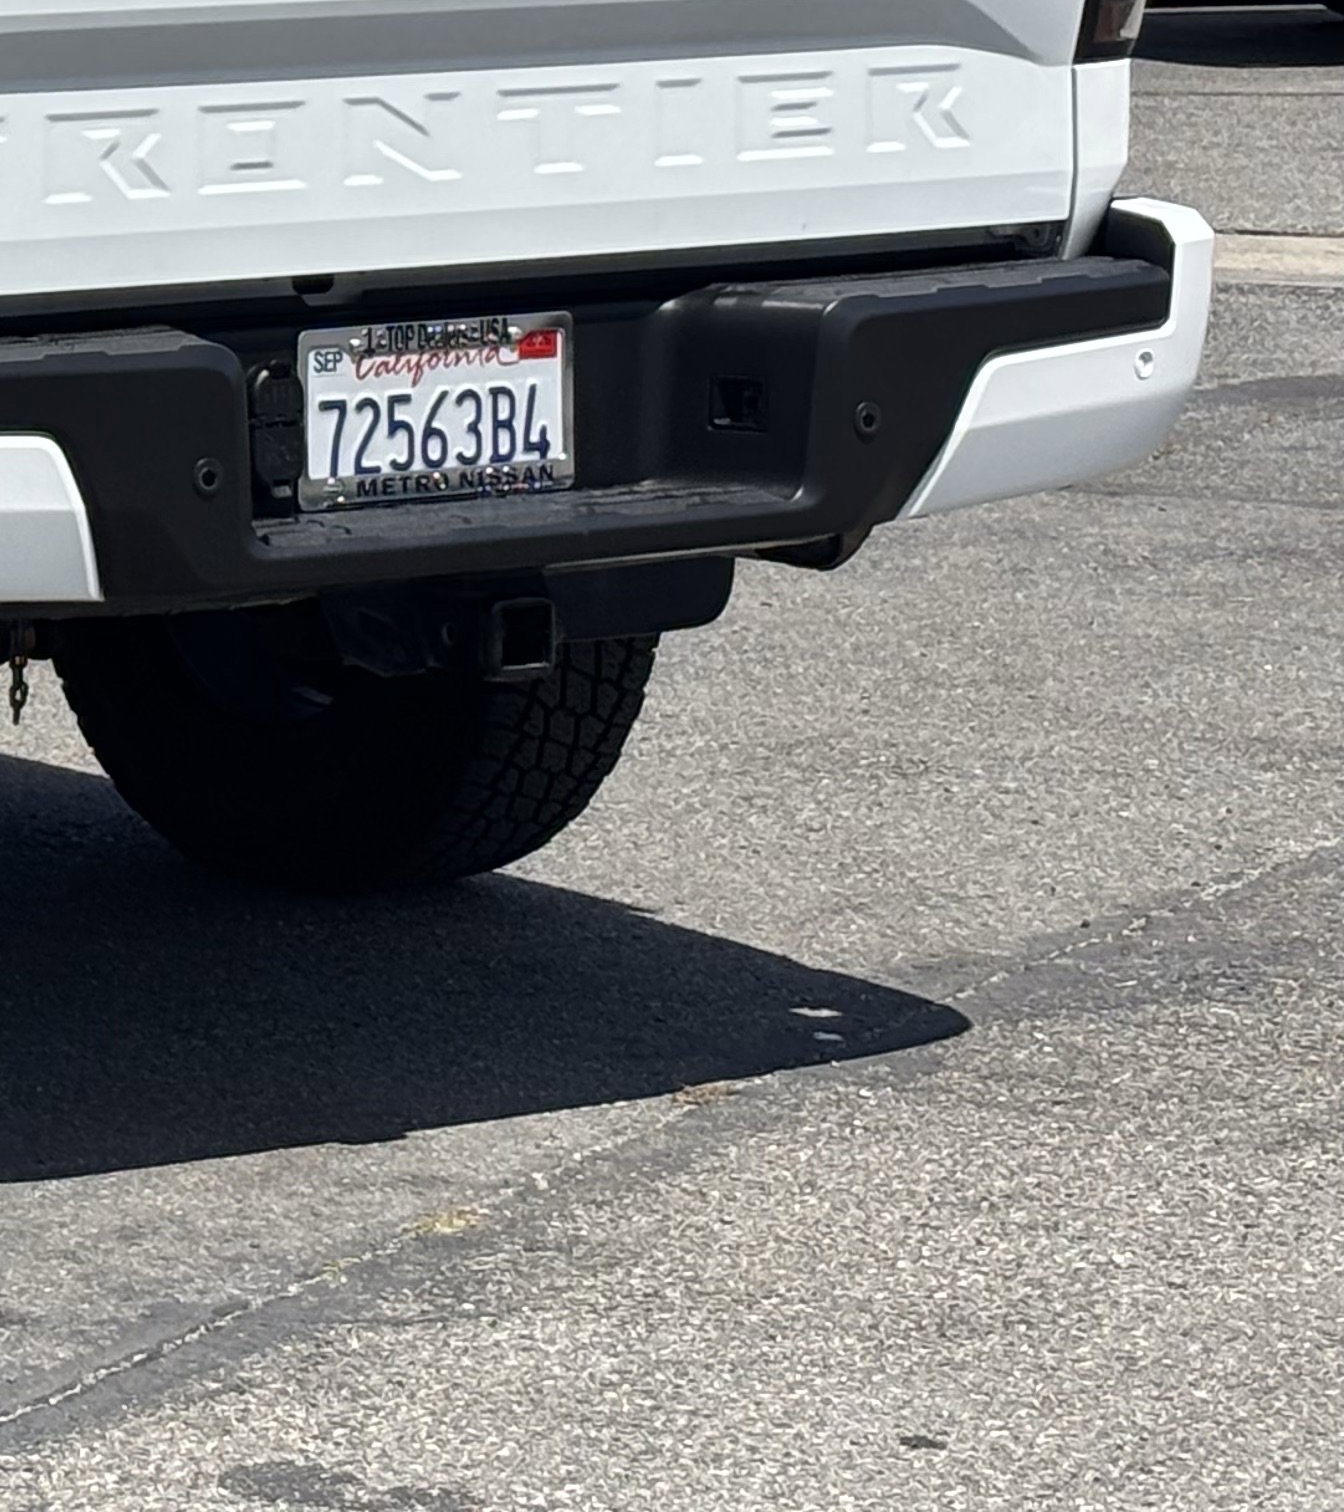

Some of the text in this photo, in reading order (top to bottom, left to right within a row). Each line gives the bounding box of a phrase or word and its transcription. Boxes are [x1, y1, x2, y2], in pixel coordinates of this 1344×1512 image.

[386, 325, 415, 351] TOP
[480, 318, 511, 345] USA
[313, 350, 343, 374] SEP
[355, 344, 520, 387] California
[318, 383, 551, 479] 72563B4
[356, 463, 554, 497] METRO NISSAN
